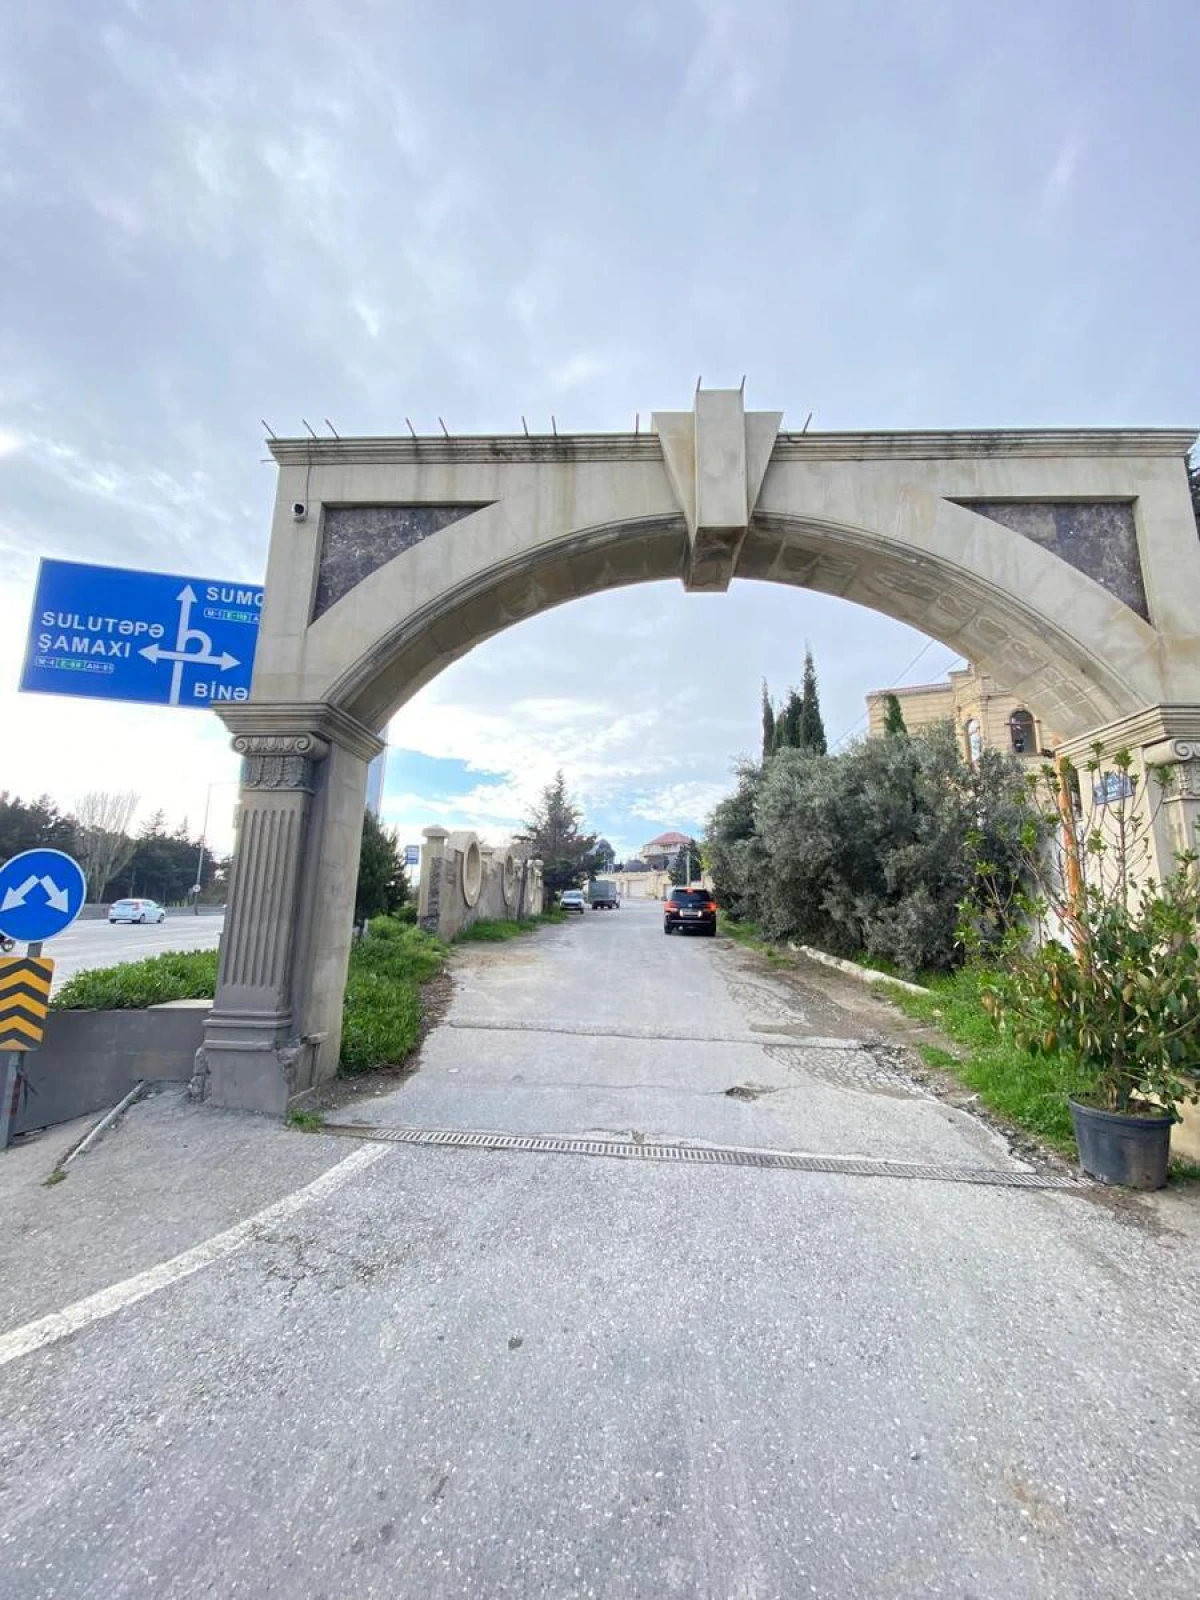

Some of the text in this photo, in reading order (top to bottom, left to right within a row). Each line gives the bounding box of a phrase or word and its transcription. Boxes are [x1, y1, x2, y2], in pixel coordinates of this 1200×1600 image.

[42, 611, 165, 638] SULUTƏPƏ
[37, 633, 132, 658] ŞAMAXI
[193, 680, 248, 701] BİNƏ
